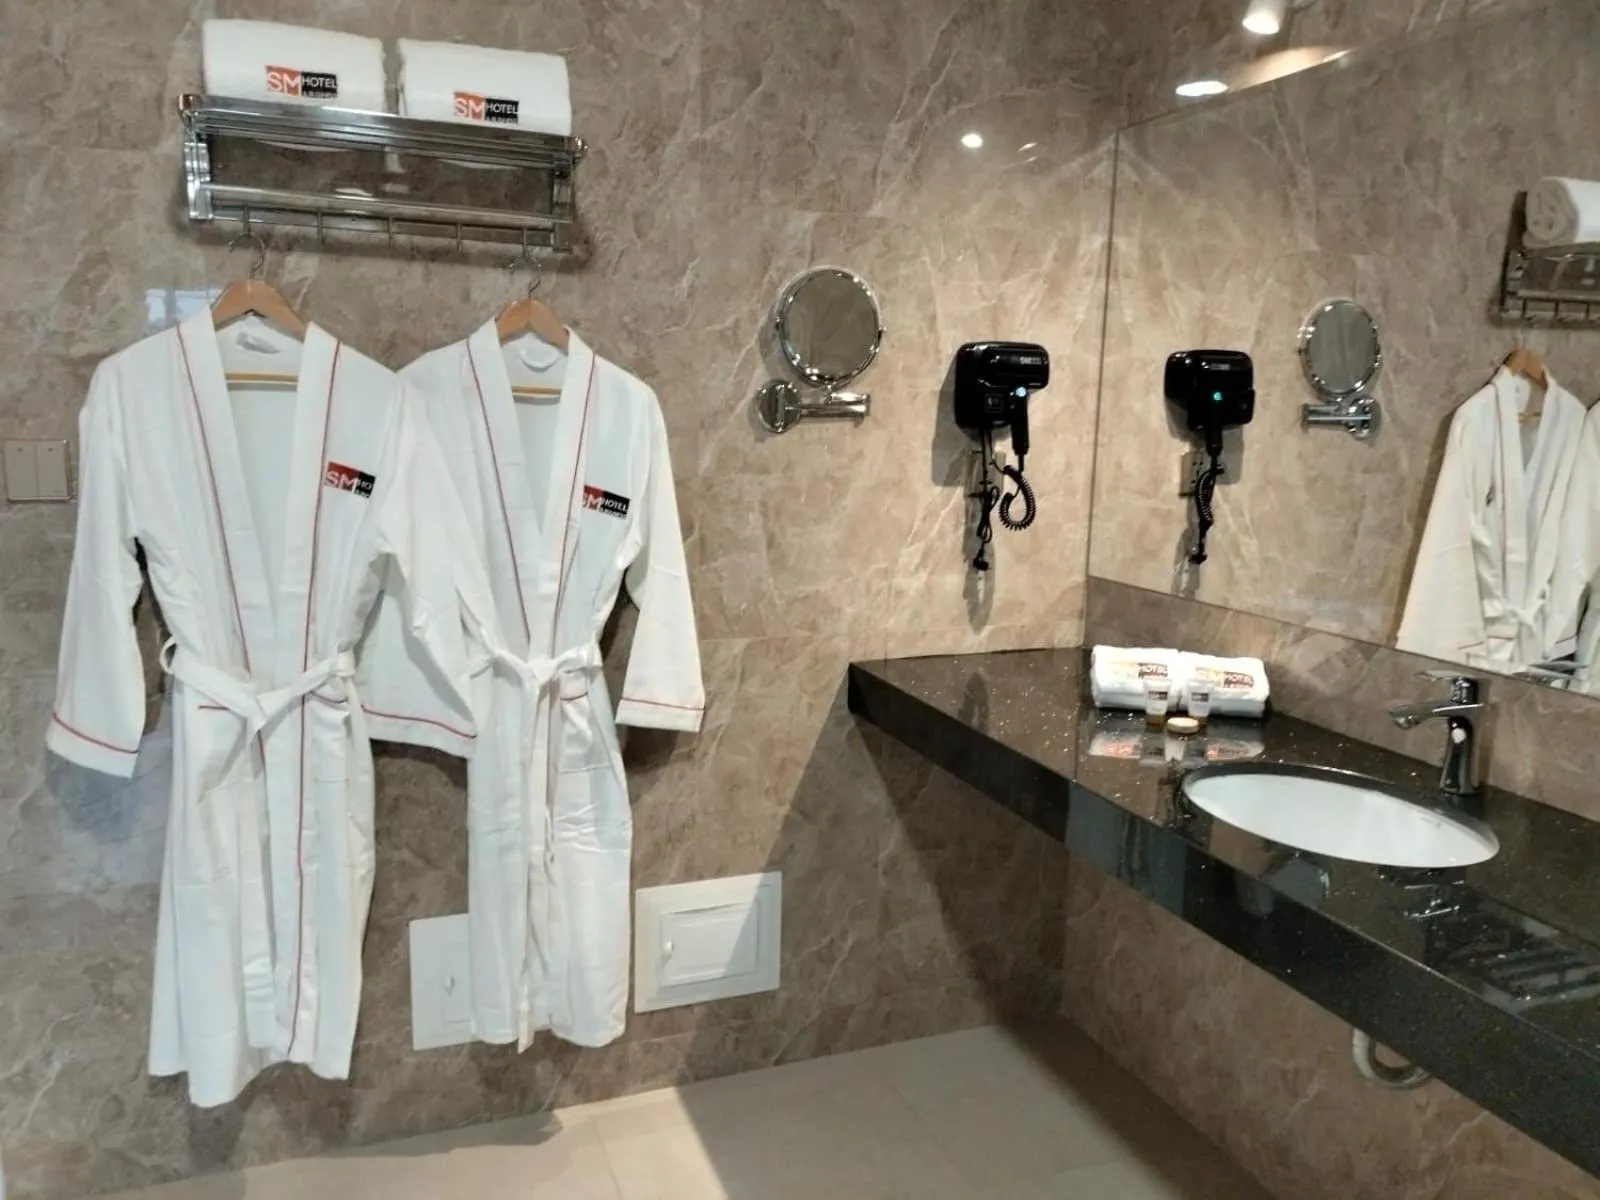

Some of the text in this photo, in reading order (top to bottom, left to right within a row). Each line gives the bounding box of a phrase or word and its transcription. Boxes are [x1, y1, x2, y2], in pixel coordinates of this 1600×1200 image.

[267, 71, 337, 96] SM HOTEL
[456, 97, 518, 121] SM HOTEL
[326, 470, 359, 492] SM
[602, 497, 627, 511] HOTEL
